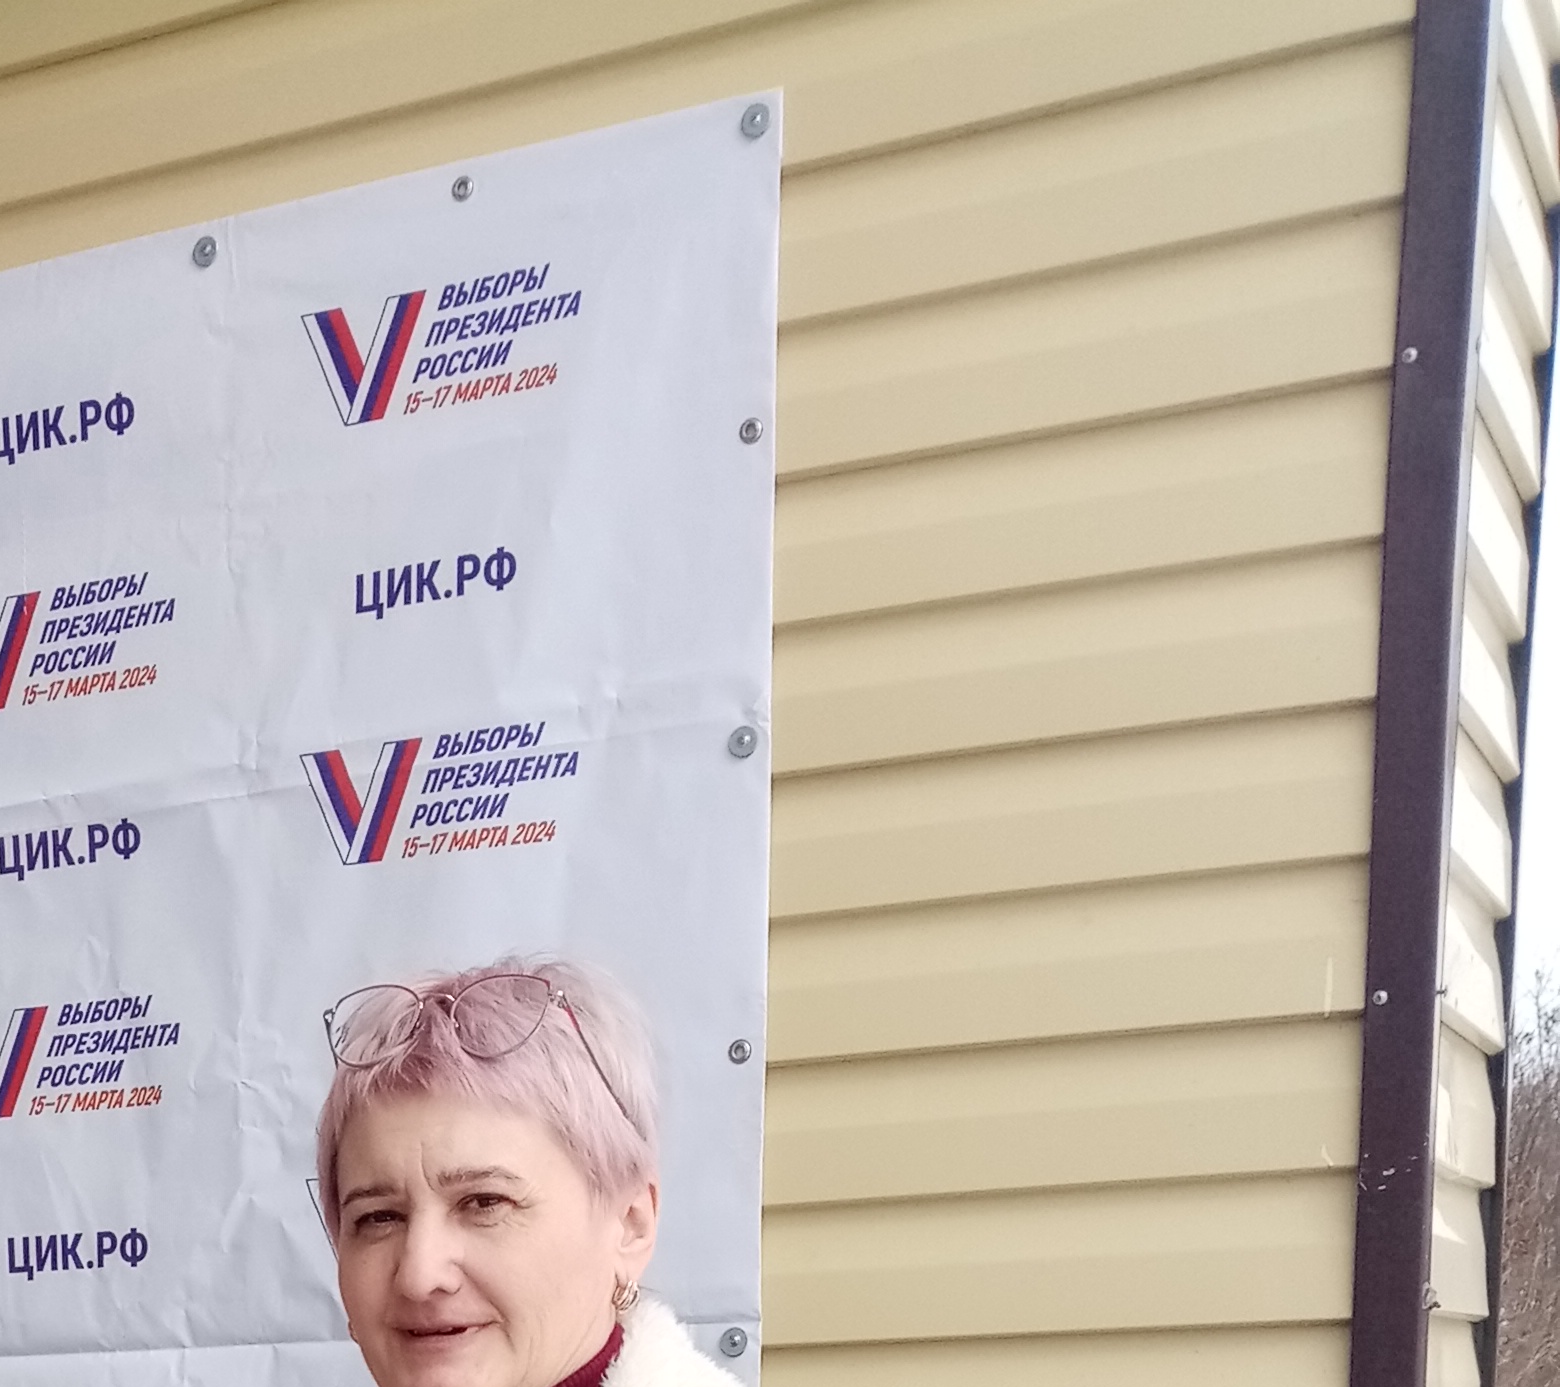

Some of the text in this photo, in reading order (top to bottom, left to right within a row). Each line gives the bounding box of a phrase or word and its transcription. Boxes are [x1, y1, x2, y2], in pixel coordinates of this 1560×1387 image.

[438, 264, 549, 311] ВЫБОРЫ
[425, 291, 581, 347] ПРЕЗИДЕНТА
[413, 340, 513, 383] РОССИИ
[452, 373, 512, 405] МАРТА
[514, 363, 557, 392] 2024
[50, 572, 148, 611] ВЫБОРЫ
[356, 547, 516, 620] ЦИК.РФ
[40, 599, 175, 644] ПРЕЗИДЕНТА
[29, 641, 116, 677] РОССИИ
[64, 671, 116, 698] МАРТА
[119, 665, 156, 689] 2024
[433, 722, 545, 759] ВЫБОРЫ
[421, 752, 578, 794] ПРЕЗИДЕНТА
[410, 793, 509, 829] РОССИИ
[448, 825, 508, 852] МАРТА
[511, 820, 555, 845] 2024
[58, 995, 152, 1026] ВЫБОРЫ
[47, 1023, 180, 1057] ПРЕЗИДЕНТА
[37, 1060, 124, 1088] РОССИИ
[72, 1089, 124, 1112] МАРТА
[126, 1085, 162, 1107] 2024
[8, 1228, 147, 1281] ЦИК.РФ
